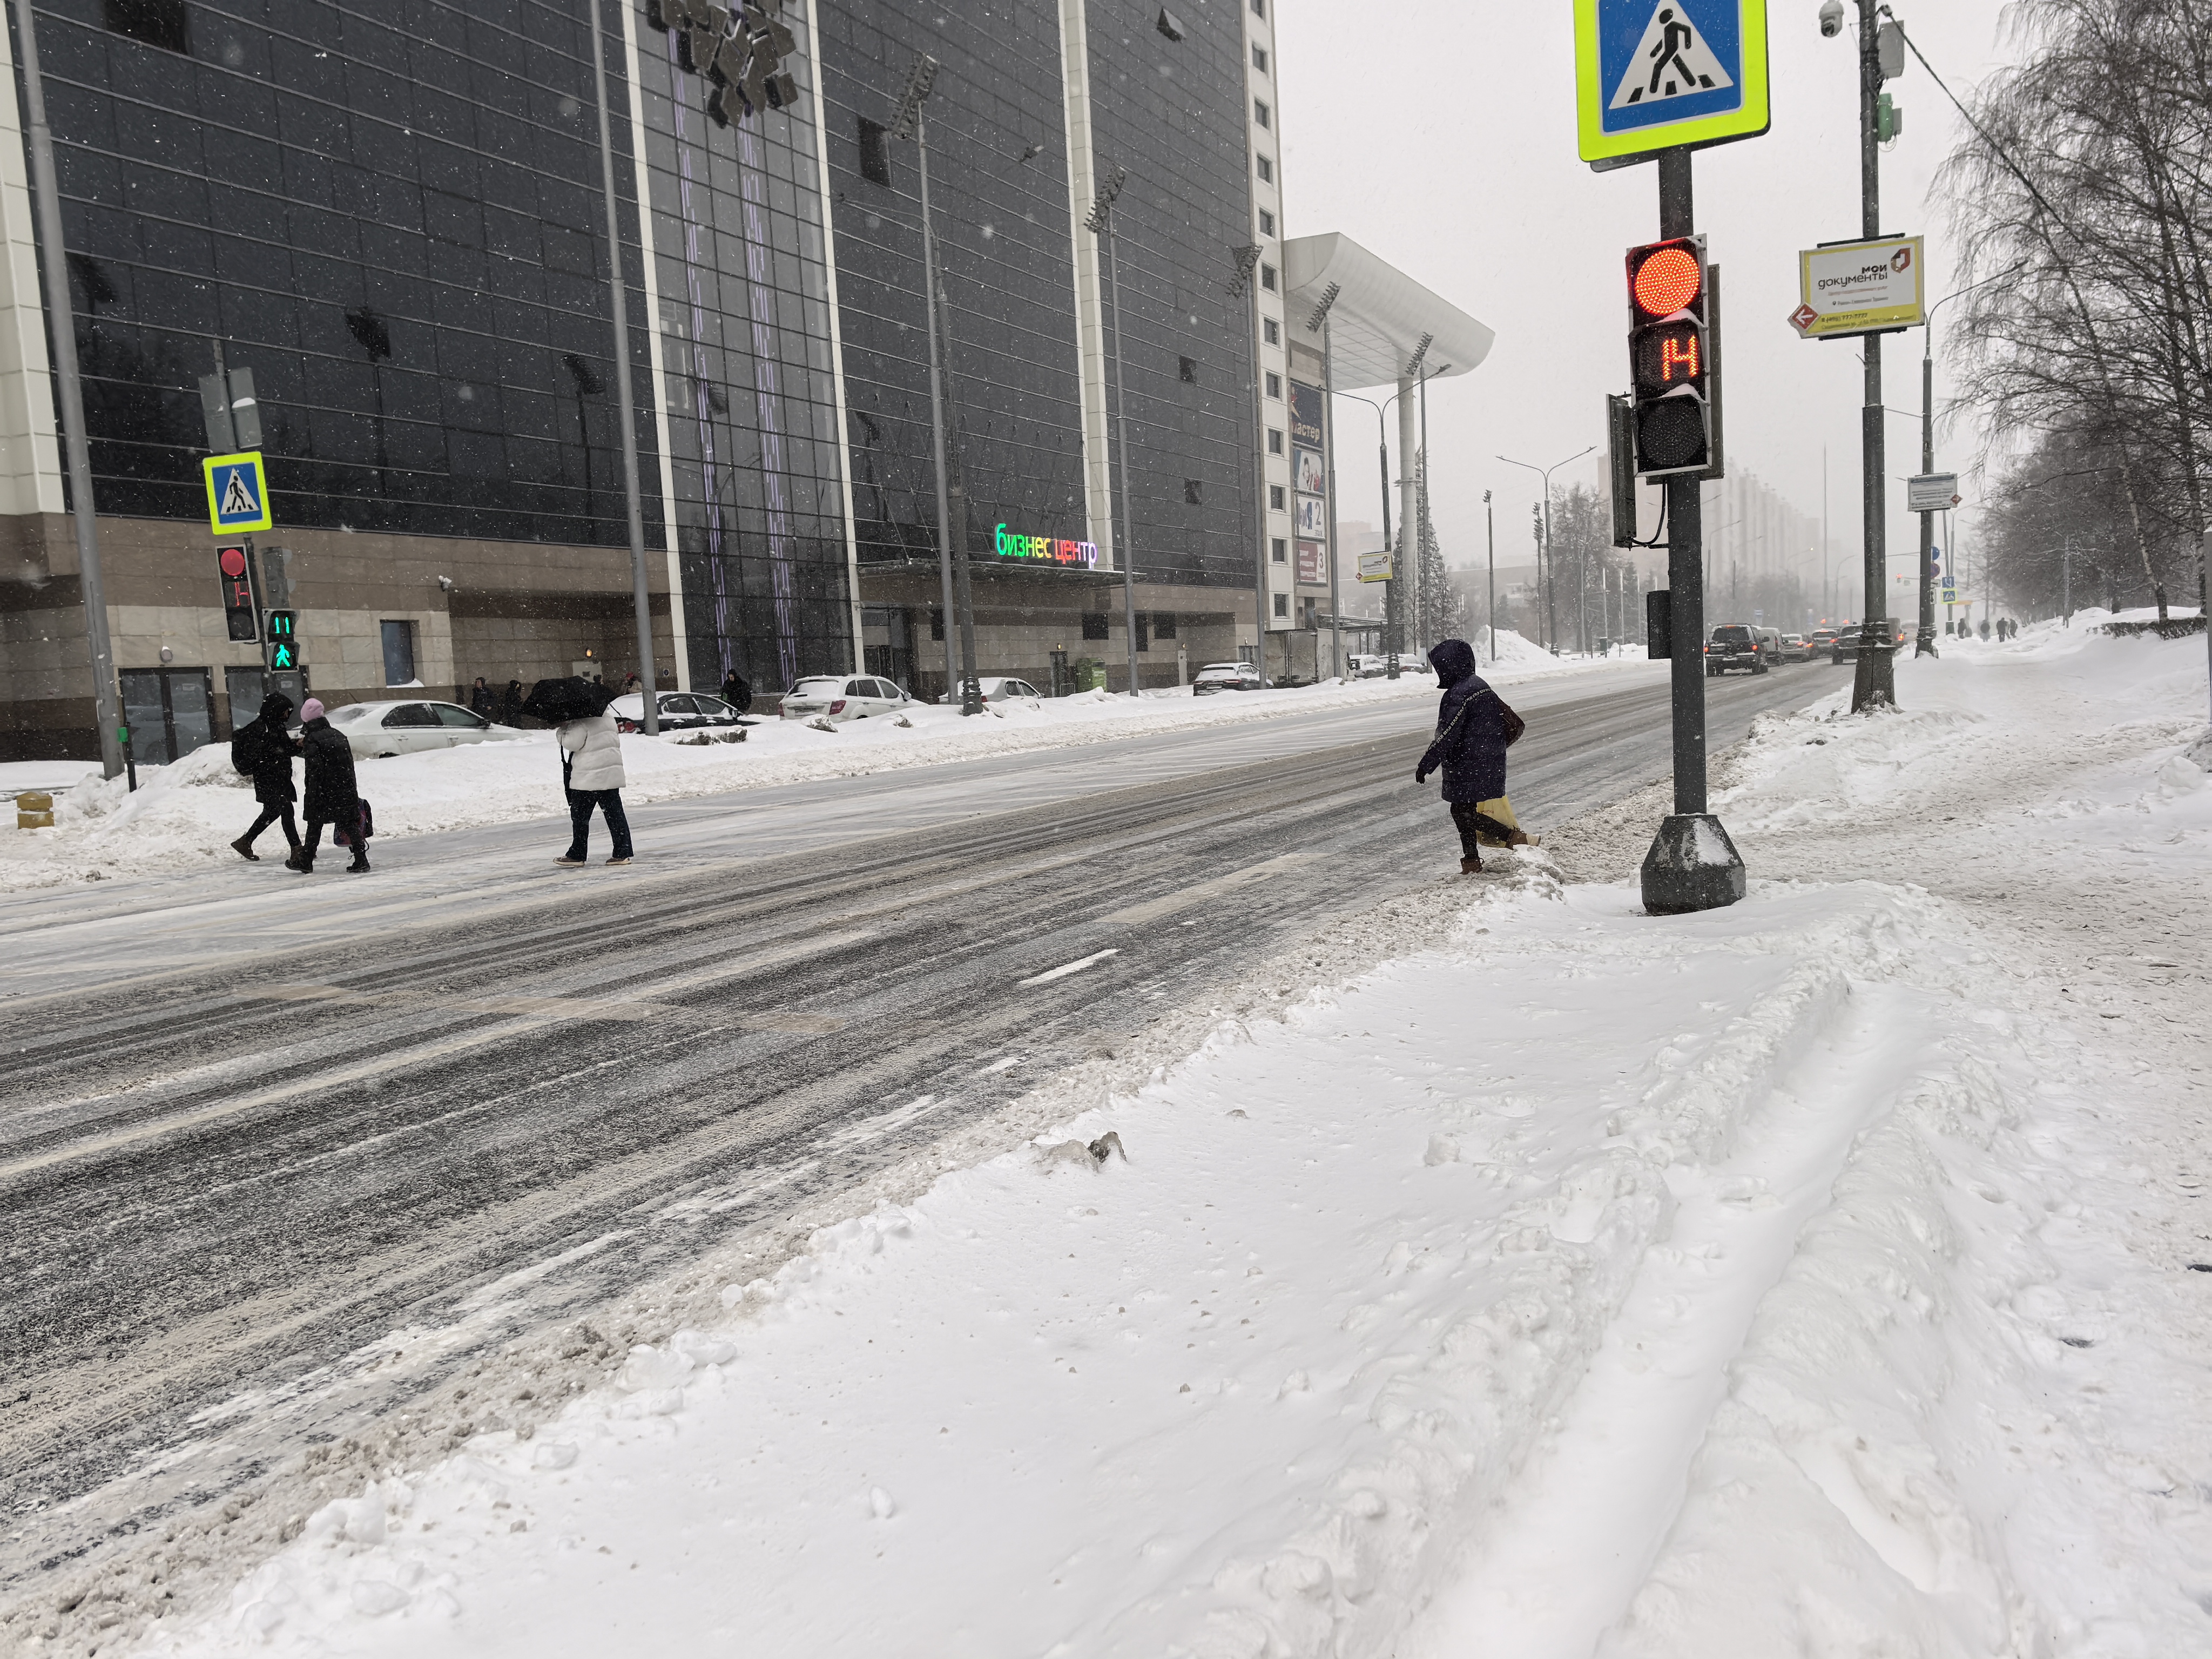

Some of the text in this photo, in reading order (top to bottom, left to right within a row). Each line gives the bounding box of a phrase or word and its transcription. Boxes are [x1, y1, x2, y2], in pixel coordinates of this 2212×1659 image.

[1818, 272, 1887, 290] документы
[1662, 334, 1698, 381] 14
[996, 523, 1097, 569] бизнес центр
[275, 617, 289, 633] 11
